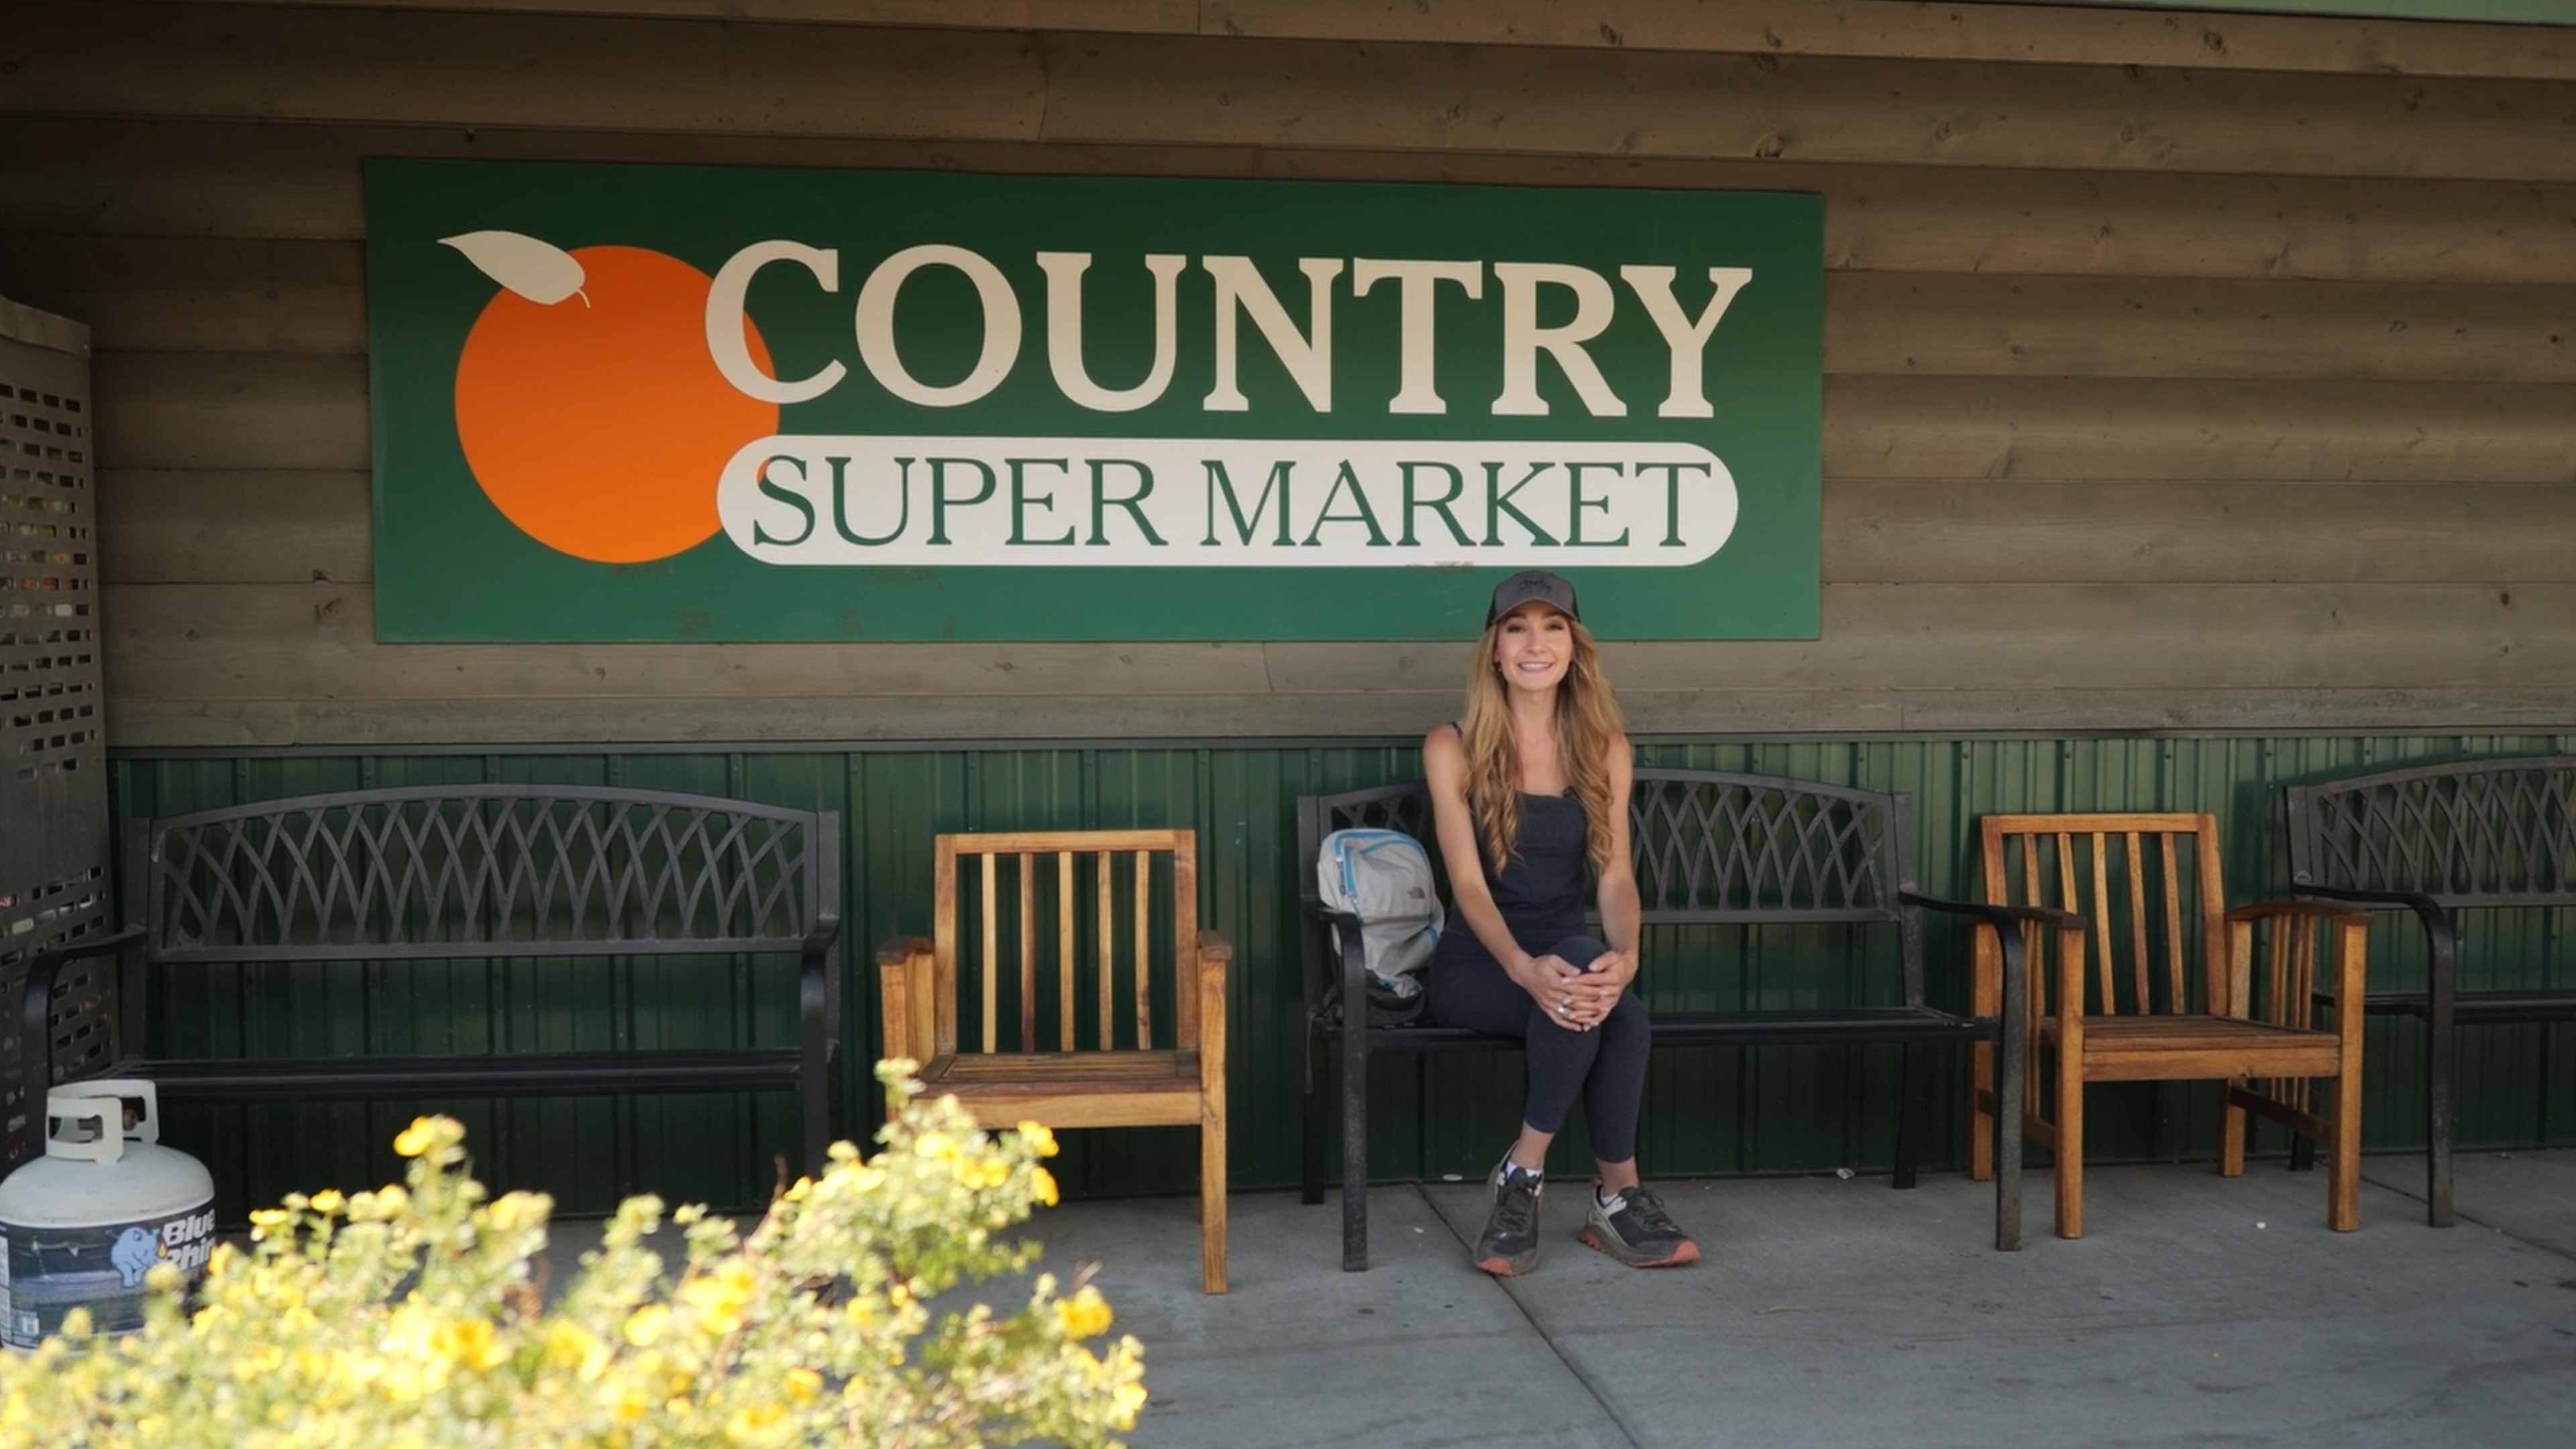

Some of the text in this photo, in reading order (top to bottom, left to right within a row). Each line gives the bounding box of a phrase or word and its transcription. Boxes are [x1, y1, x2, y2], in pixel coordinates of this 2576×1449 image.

[705, 239, 1753, 419] COUNTRY
[753, 453, 1712, 547] SUPER MARKET
[162, 1208, 215, 1247] Blue
